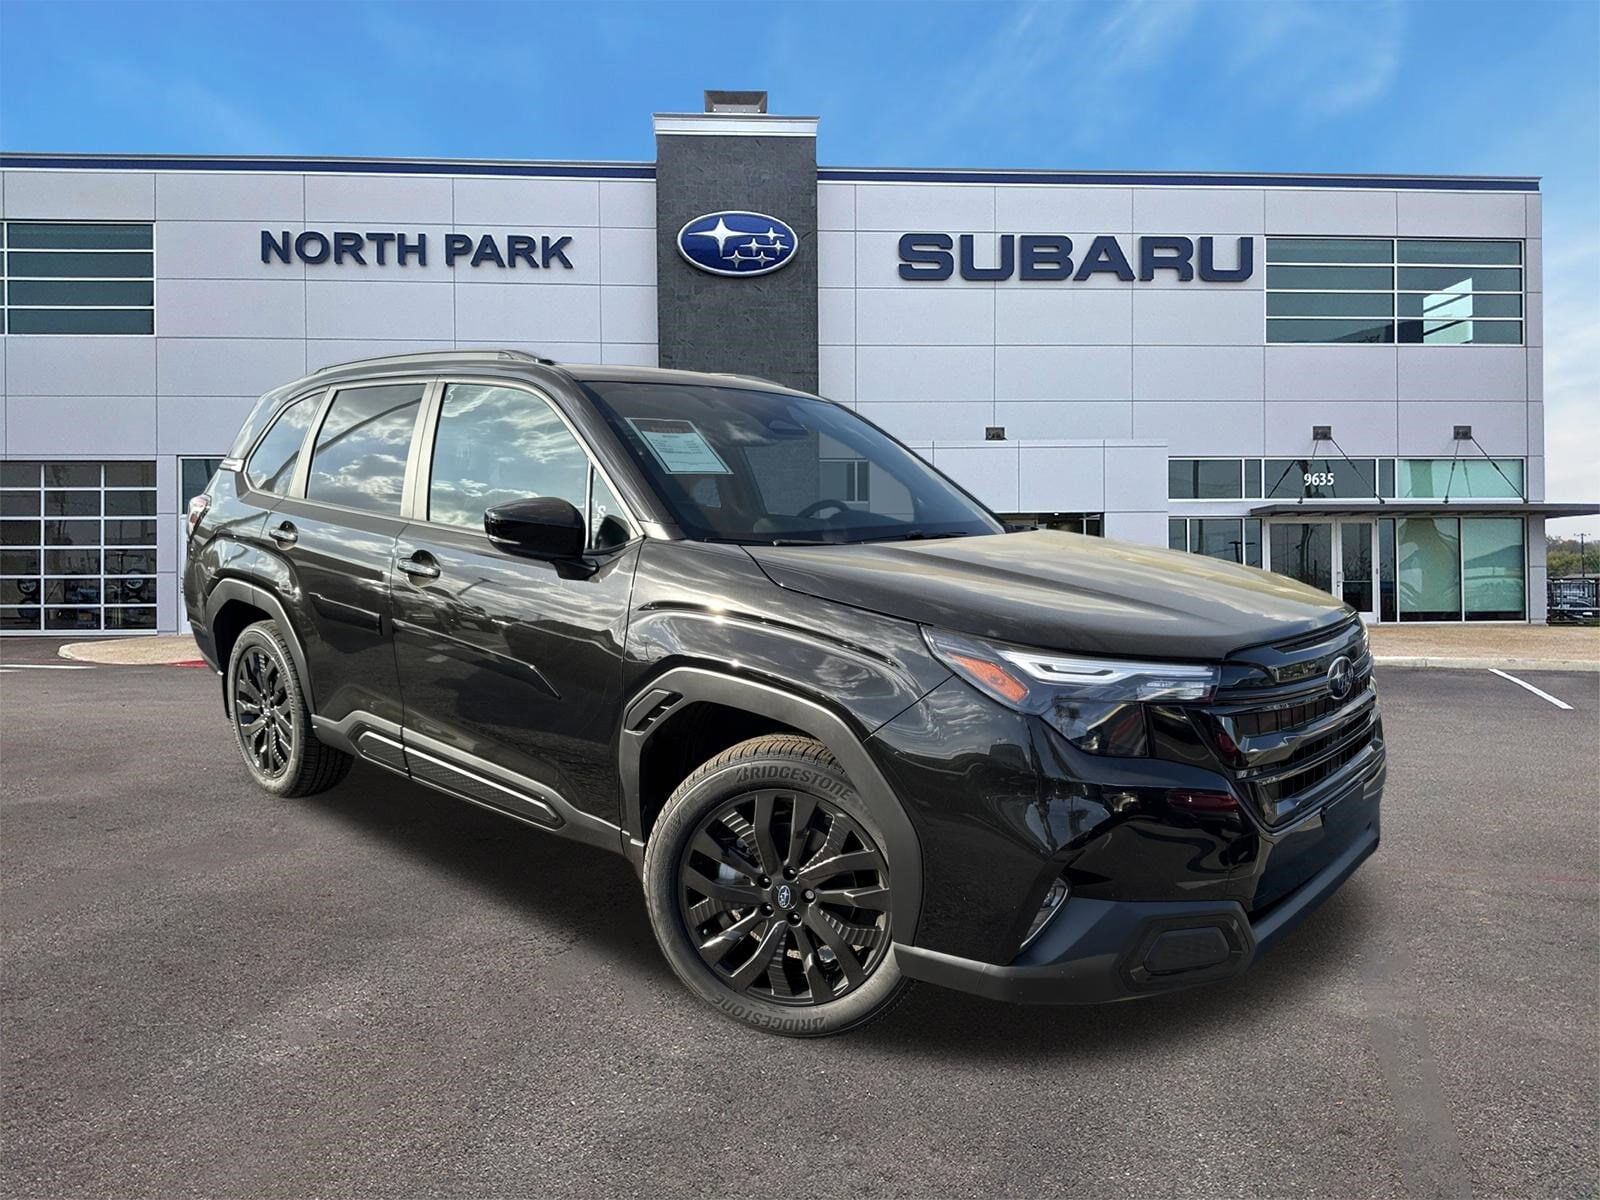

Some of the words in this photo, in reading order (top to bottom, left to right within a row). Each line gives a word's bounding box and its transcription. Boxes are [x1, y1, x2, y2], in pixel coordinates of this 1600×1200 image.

[260, 230, 427, 267] NORTH
[445, 233, 574, 269] PARK
[898, 233, 1254, 282] SUBARU
[1303, 472, 1335, 486] 9635
[736, 765, 854, 801] BRIDGESTONE
[712, 993, 828, 1033] BRIDGESTONE
